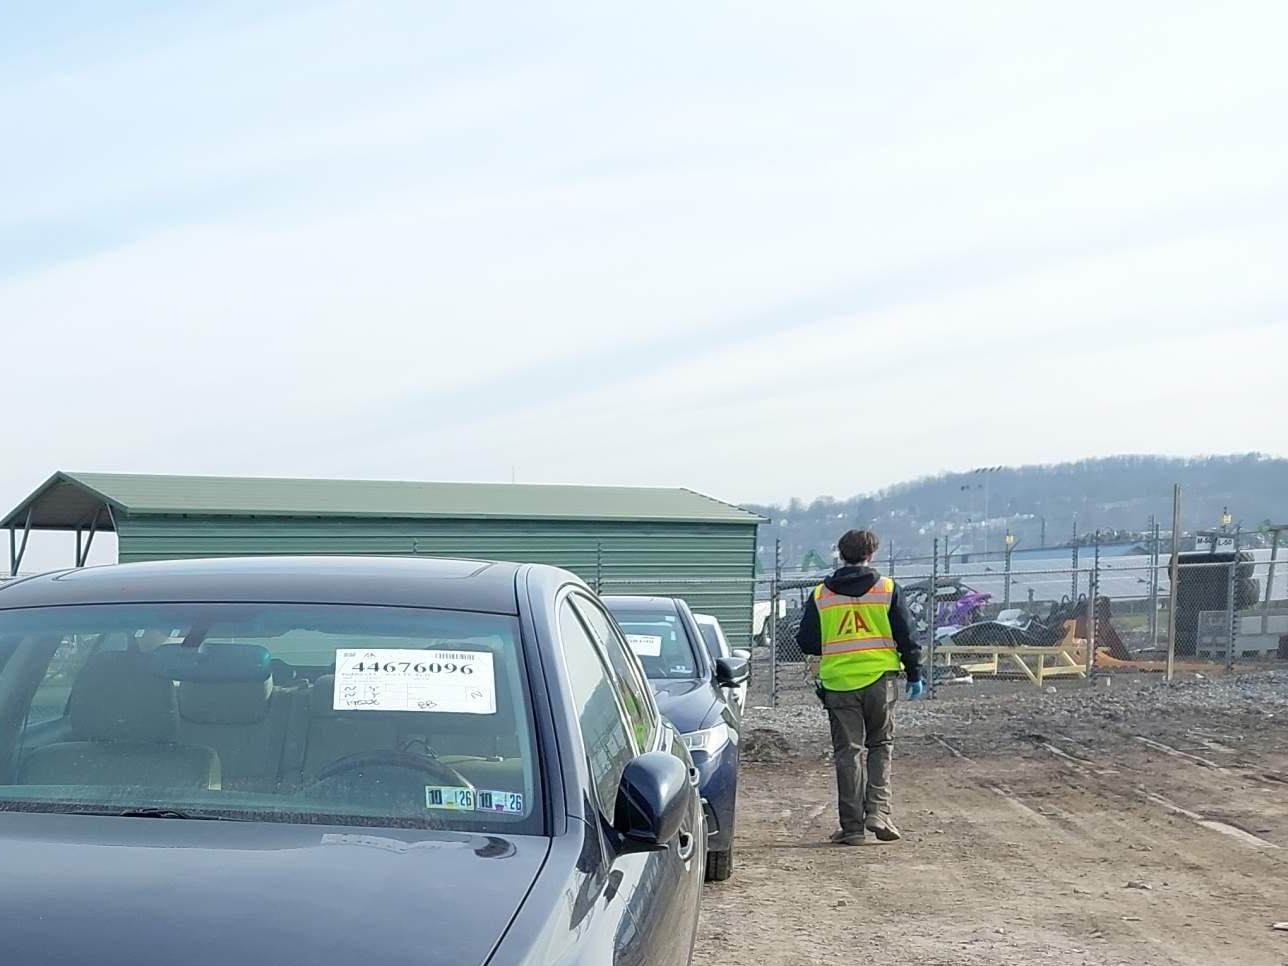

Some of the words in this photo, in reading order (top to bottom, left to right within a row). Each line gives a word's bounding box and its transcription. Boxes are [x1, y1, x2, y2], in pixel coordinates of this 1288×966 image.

[351, 661, 474, 675] 44676096
[428, 789, 443, 805] 10
[459, 790, 472, 807] 26
[479, 792, 493, 809] 10
[509, 794, 522, 812] 26
